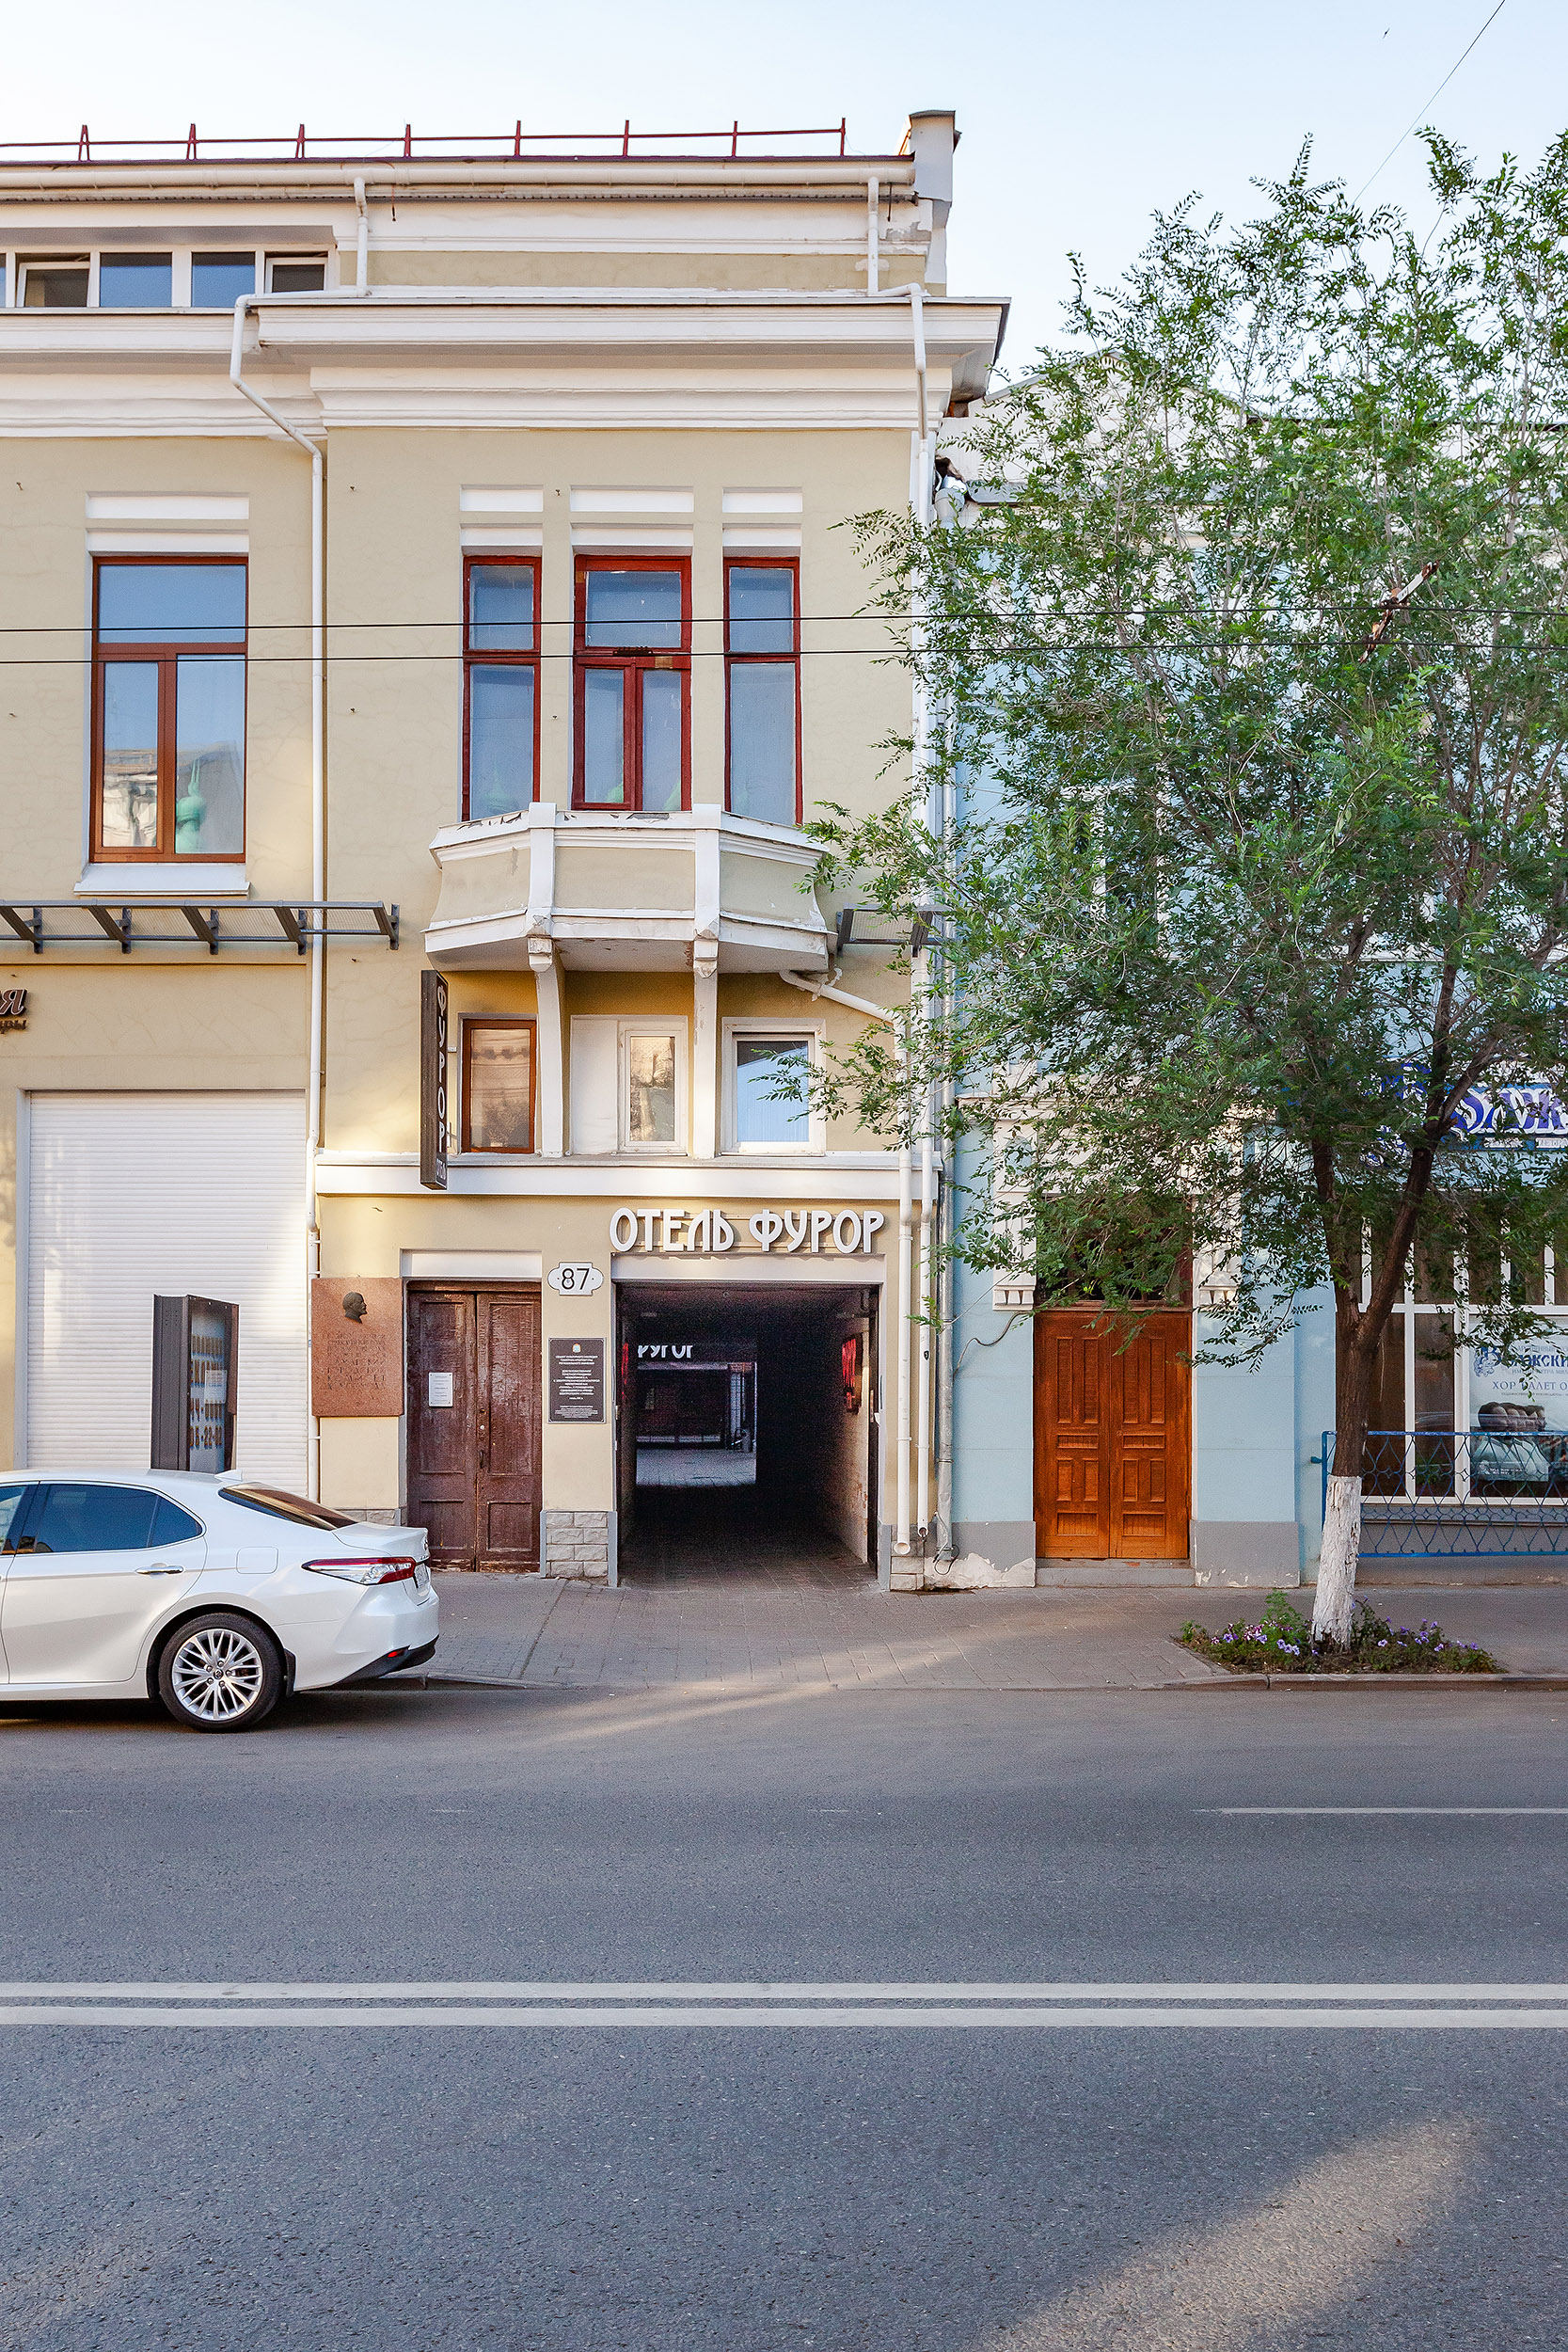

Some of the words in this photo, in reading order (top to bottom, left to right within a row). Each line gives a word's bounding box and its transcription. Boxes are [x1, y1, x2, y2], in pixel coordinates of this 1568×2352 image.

[437, 985, 446, 1152] ФУРОР
[610, 1207, 735, 1252] ОТЕЛЬ
[749, 1209, 884, 1253] ФУРОР
[562, 1268, 589, 1290] 87
[1493, 1381, 1516, 1390] ХОР
